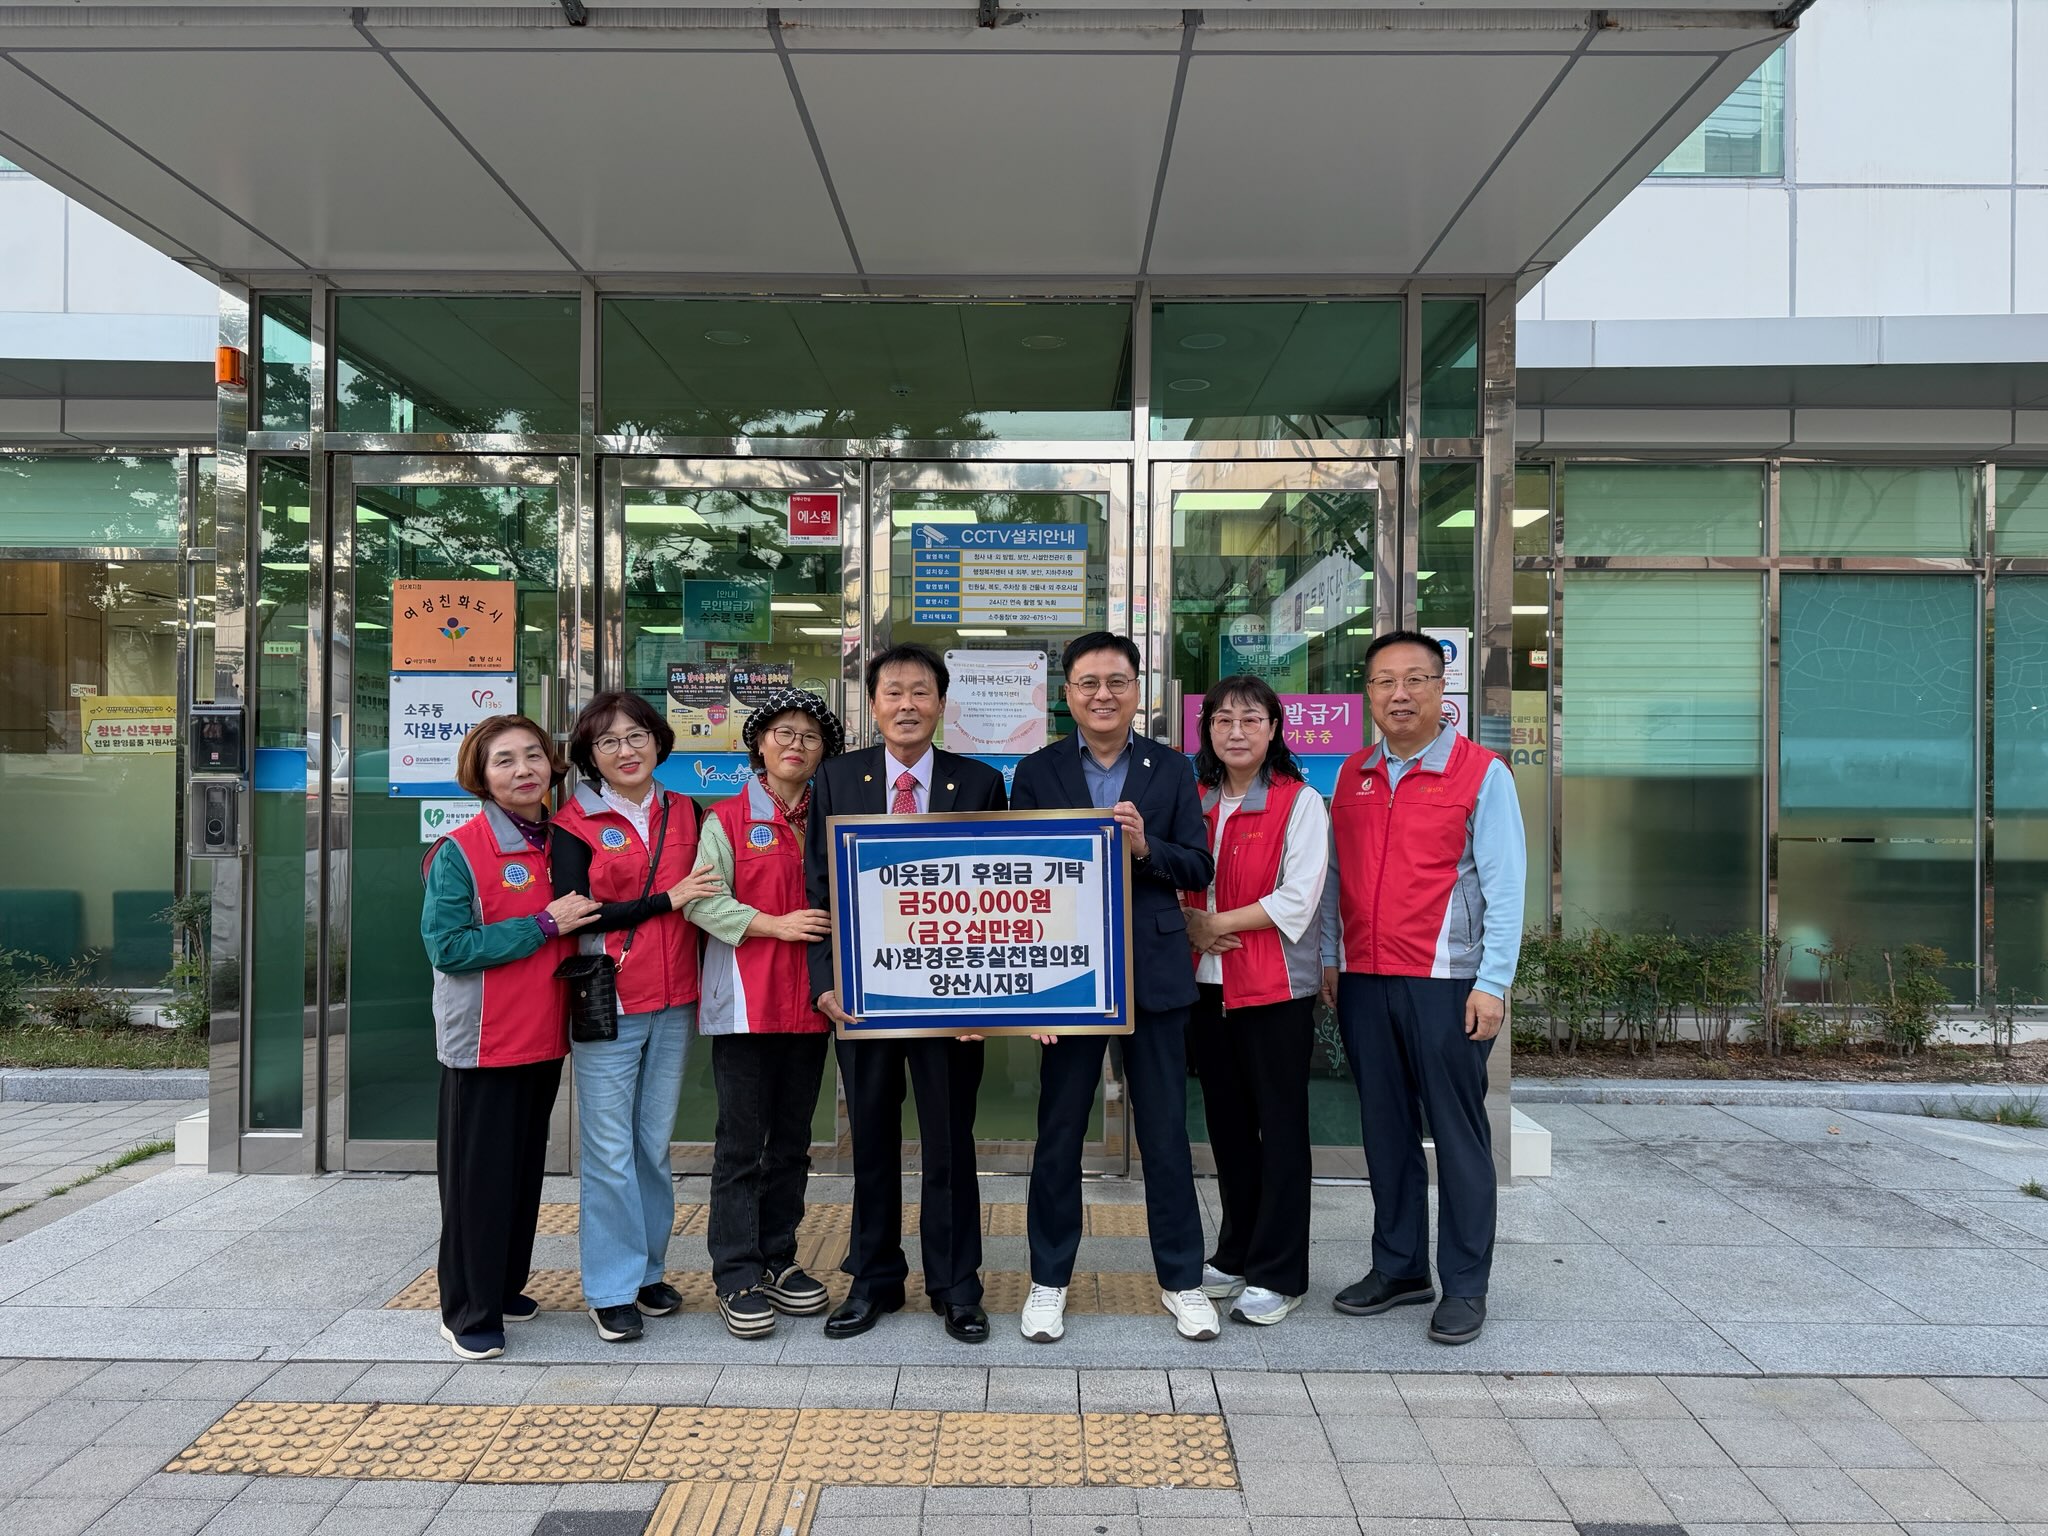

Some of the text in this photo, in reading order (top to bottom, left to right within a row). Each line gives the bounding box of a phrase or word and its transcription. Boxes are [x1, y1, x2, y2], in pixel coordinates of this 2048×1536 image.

[797, 510, 831, 523] 에스원
[961, 529, 1075, 544] CCTV설치안내
[716, 590, 738, 598] [안내]
[404, 594, 503, 623] 여성친화도시
[701, 601, 754, 611] 무인발급기
[700, 613, 754, 623] 수수료 무료
[1237, 654, 1290, 665] 무인발급기
[671, 672, 686, 683] 소주동
[1270, 667, 1291, 677] 무료
[734, 673, 749, 684] 소주동
[959, 674, 1031, 685] 치매극복선도기관
[404, 703, 444, 718] 소주동
[94, 739, 110, 747] 전입
[113, 739, 144, 747] 환영물품
[879, 861, 1085, 886] 이웃돕기 후원금 기탁
[899, 888, 1051, 916] 금500,000원
[908, 919, 1044, 945] (금오십만원)
[873, 945, 1089, 970] 사)환경운동실천협의회
[930, 973, 1033, 995] 양산시지회
